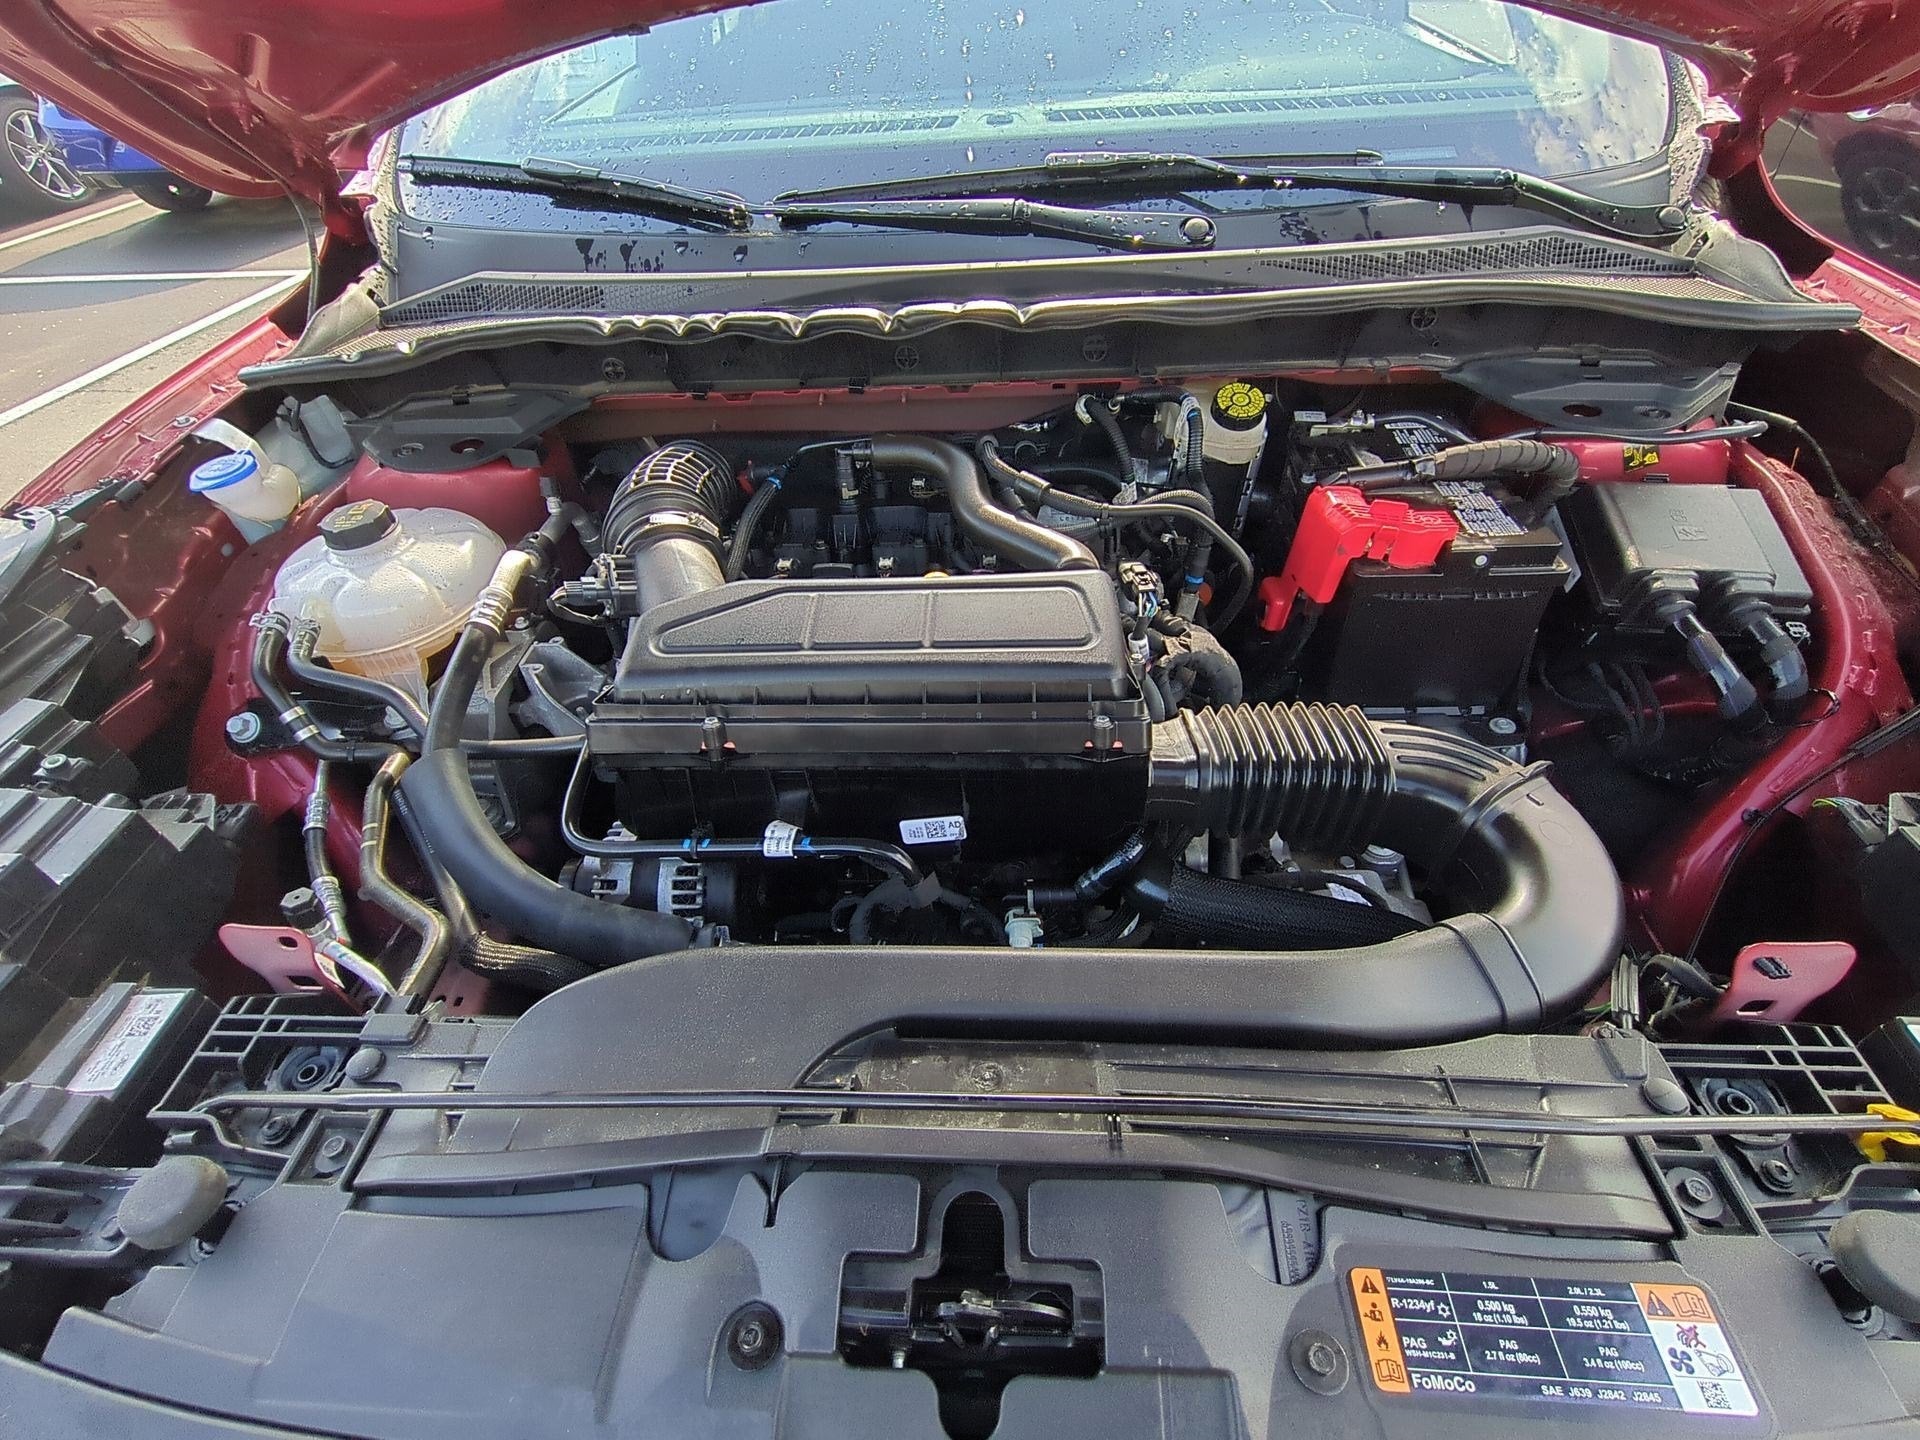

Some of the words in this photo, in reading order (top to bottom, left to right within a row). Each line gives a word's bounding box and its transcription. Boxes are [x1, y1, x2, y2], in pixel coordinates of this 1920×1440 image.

[948, 820, 961, 829] AD
[1391, 1297, 1436, 1313] R-1234yf
[1477, 1299, 1501, 1312] 0.500
[1502, 1301, 1516, 1315] kg
[1573, 1304, 1597, 1317] 0.550
[1599, 1305, 1614, 1320] kg
[1494, 1313, 1511, 1324] (1.10
[1512, 1315, 1529, 1326] lbs)
[1566, 1317, 1583, 1328] 19.5
[1584, 1320, 1595, 1328] oz
[1594, 1320, 1614, 1330] (1.21
[1614, 1320, 1630, 1332] lbs)
[1402, 1336, 1427, 1349] PAG
[1498, 1339, 1519, 1350] PAG
[1484, 1350, 1497, 1361] 2.7
[1506, 1353, 1516, 1362] oz
[1598, 1346, 1619, 1358] PAG
[1582, 1357, 1596, 1368] 3.4
[1604, 1361, 1615, 1369] oz
[1615, 1359, 1645, 1373] (100cc)
[1411, 1373, 1477, 1393] FoMoCo
[1540, 1384, 1565, 1397] SAE
[1568, 1386, 1593, 1398] J639
[1597, 1388, 1627, 1401] J2842
[1632, 1391, 1662, 1403] J2845
